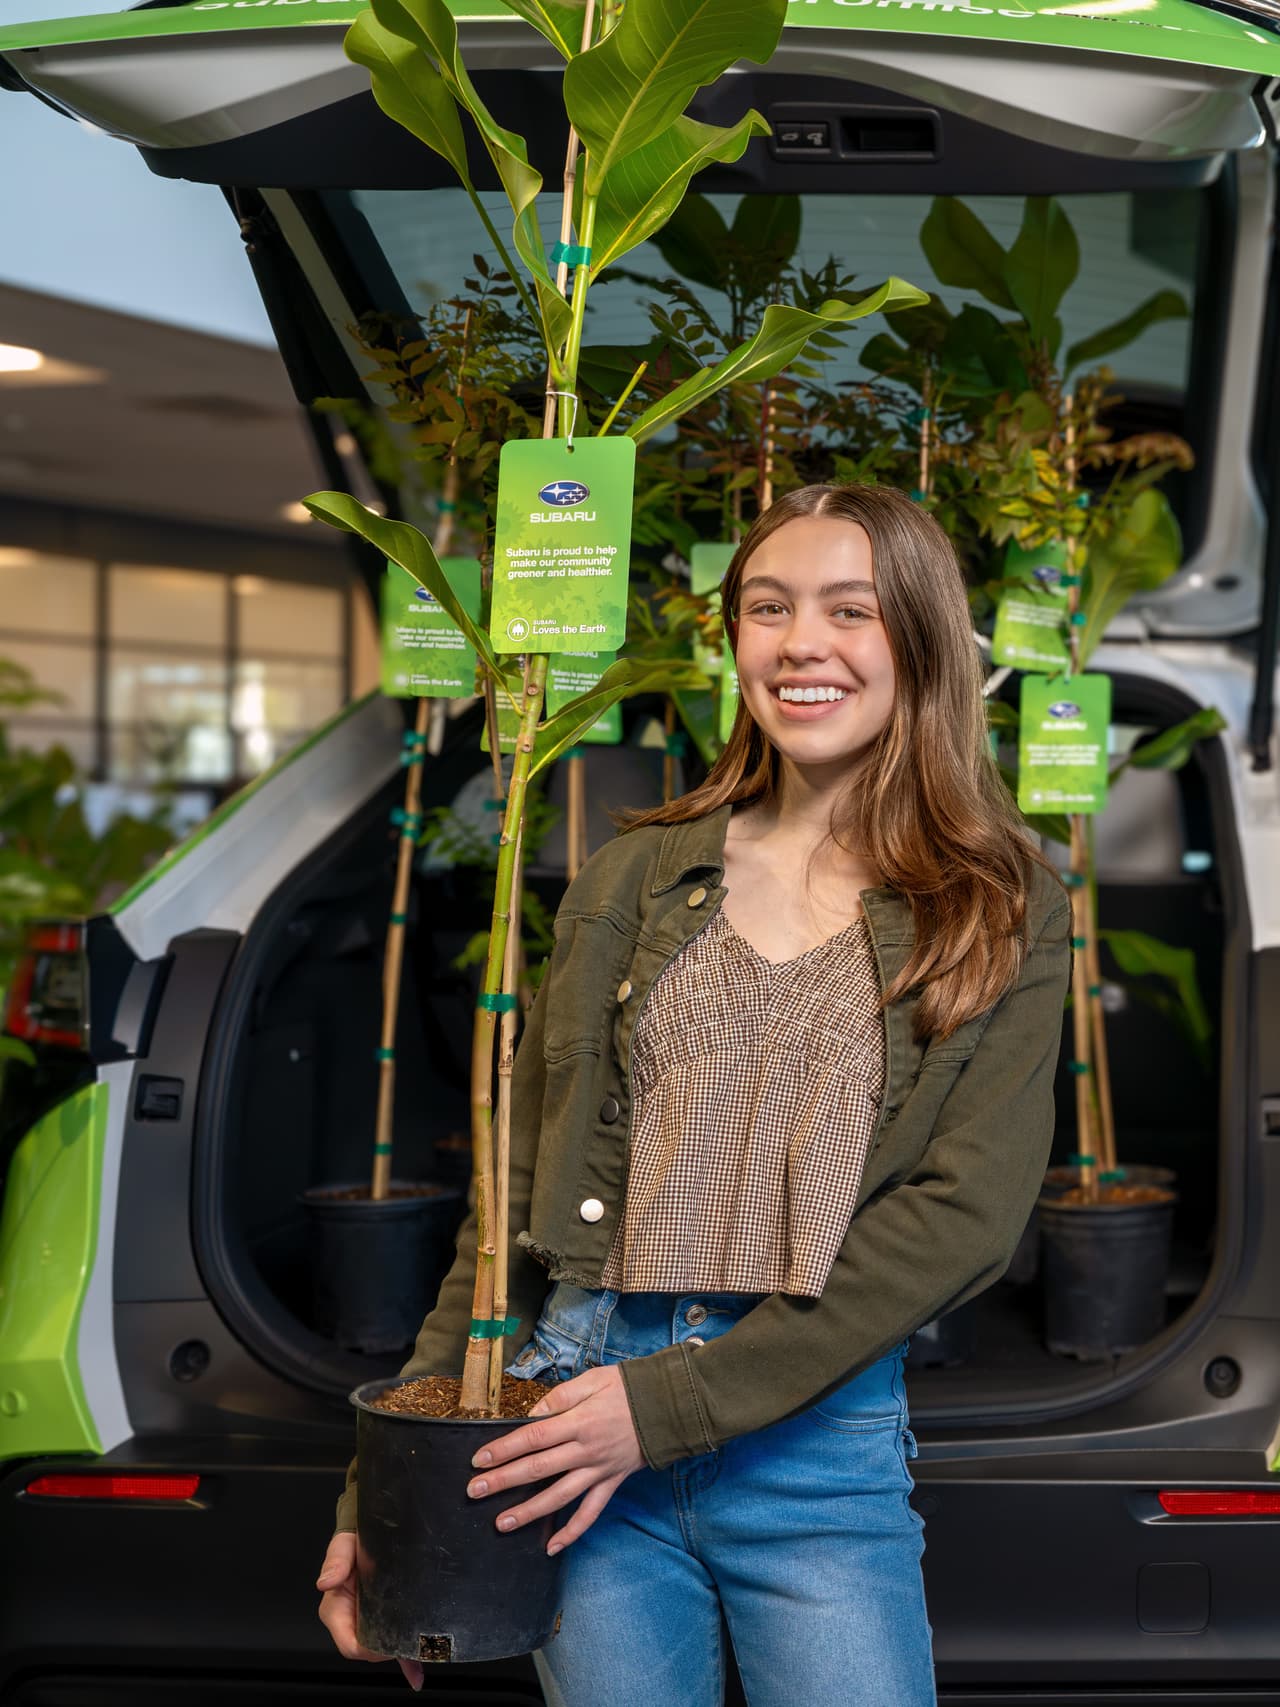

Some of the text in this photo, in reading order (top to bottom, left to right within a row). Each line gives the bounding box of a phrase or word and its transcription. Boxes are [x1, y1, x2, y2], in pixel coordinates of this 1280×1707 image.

[529, 511, 596, 523] SUBARU
[506, 545, 617, 559] Subaru is proud to help
[510, 558, 536, 568] make
[558, 556, 612, 567] community
[508, 566, 612, 580] greener and healthier.
[408, 604, 445, 614] SUBA
[532, 624, 606, 635] Loves the Earth
